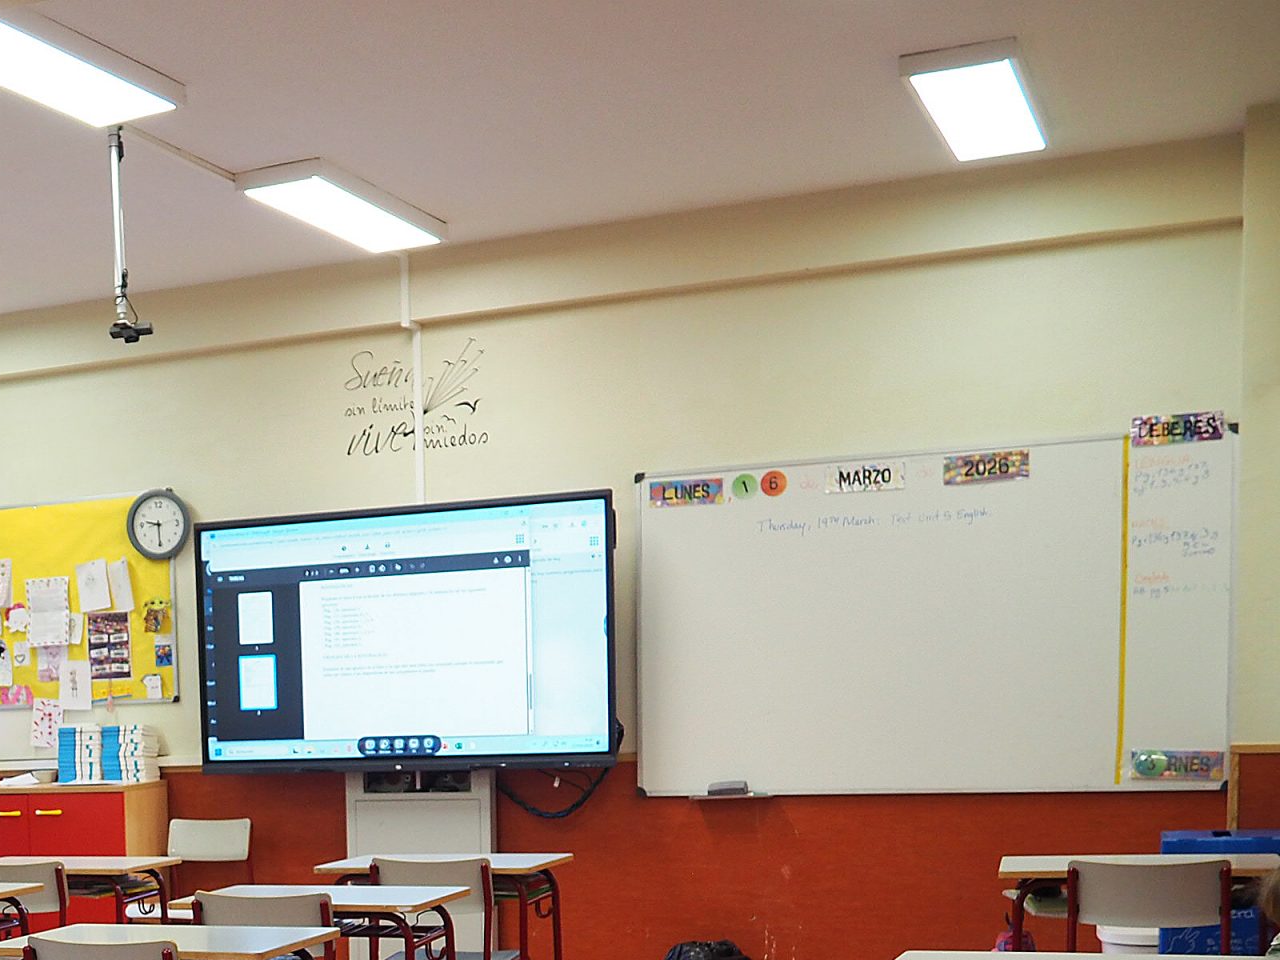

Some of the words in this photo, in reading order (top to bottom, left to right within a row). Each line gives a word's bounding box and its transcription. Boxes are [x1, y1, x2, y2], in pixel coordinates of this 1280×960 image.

[344, 406, 366, 417] sin
[372, 396, 415, 414] límite
[423, 424, 488, 448] miedos
[1138, 414, 1217, 438] DEBERES
[346, 421, 408, 457] vive
[662, 482, 711, 501] LUNES
[741, 479, 750, 494] 1
[768, 475, 778, 491] 6
[838, 466, 892, 487] MARZO
[963, 457, 1010, 478] 2026
[154, 500, 163, 508] 12
[175, 518, 180, 527] 3
[1166, 755, 1211, 773] RNES
